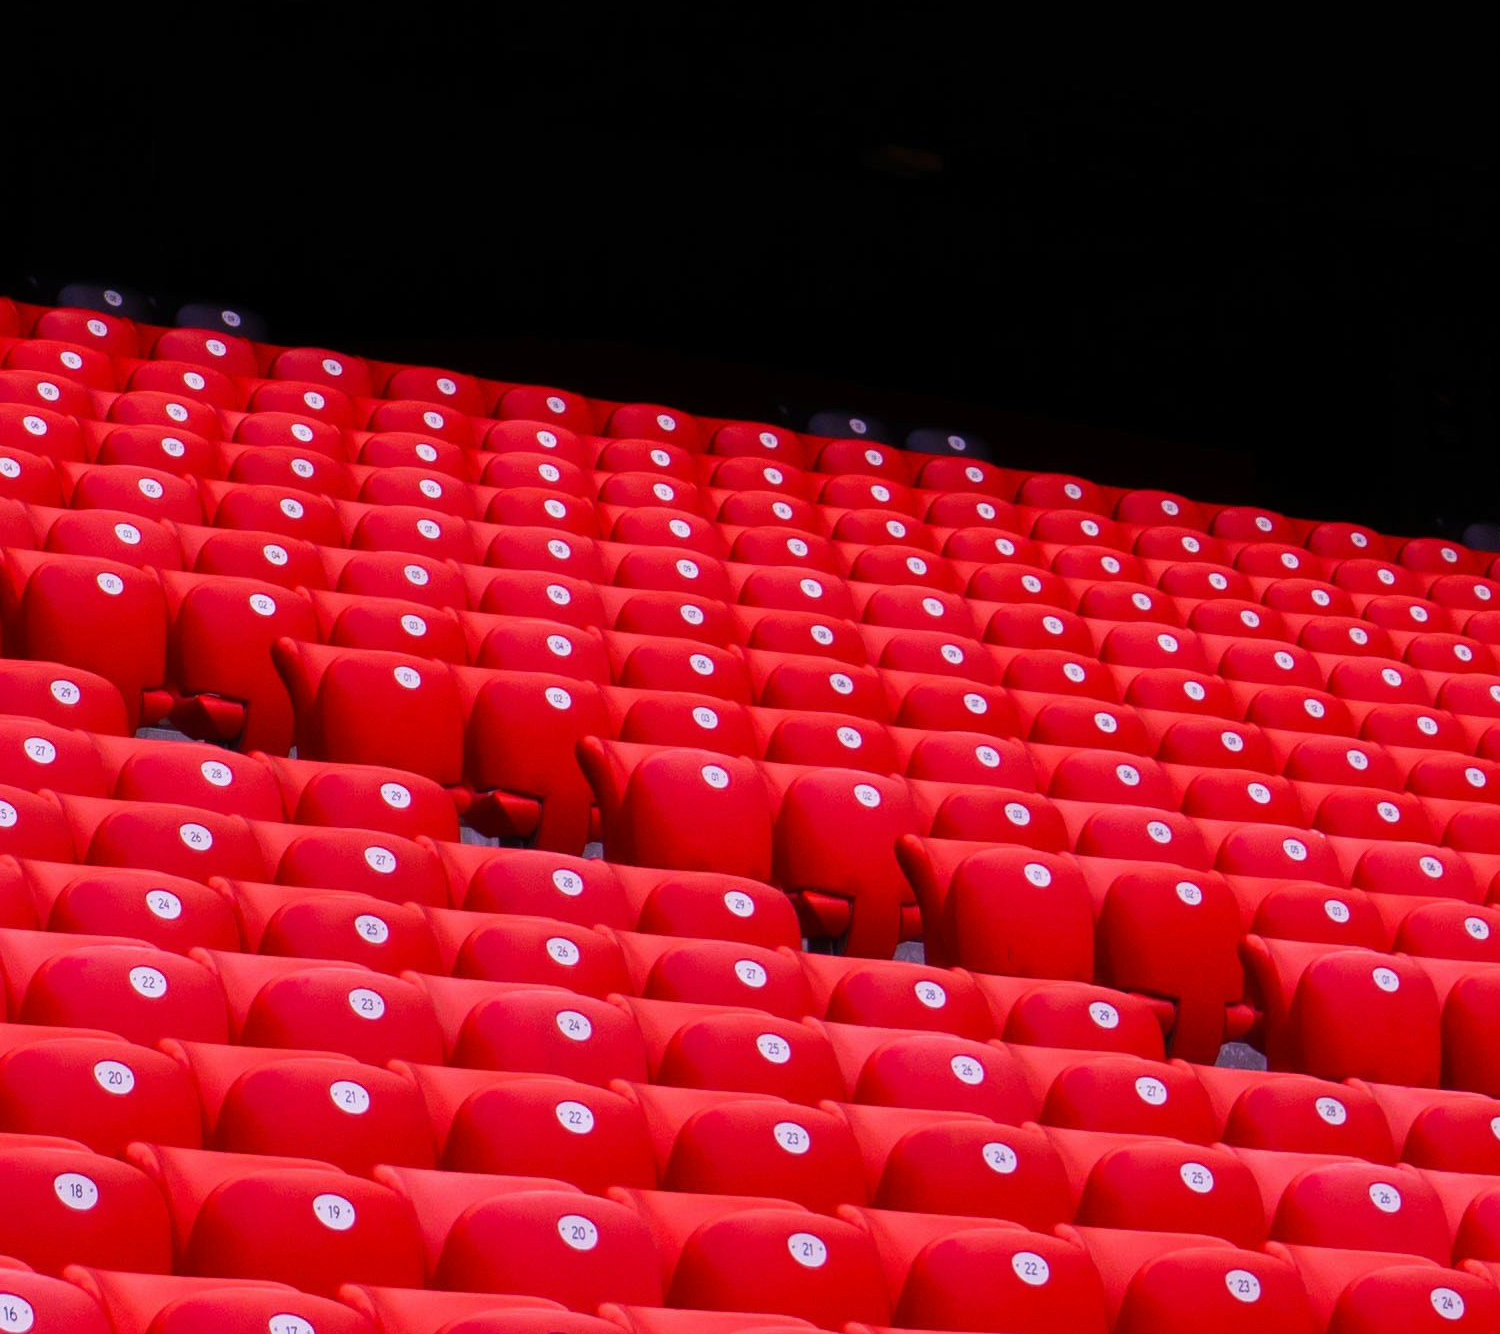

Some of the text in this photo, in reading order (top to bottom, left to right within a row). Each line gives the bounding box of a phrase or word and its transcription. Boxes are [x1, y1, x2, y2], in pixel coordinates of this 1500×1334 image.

[158, 897, 170, 910] 24
[345, 1089, 356, 1104] 21
[70, 1183, 84, 1199] 18
[571, 1225, 586, 1241] 20
[3, 1306, 18, 1323] 16
